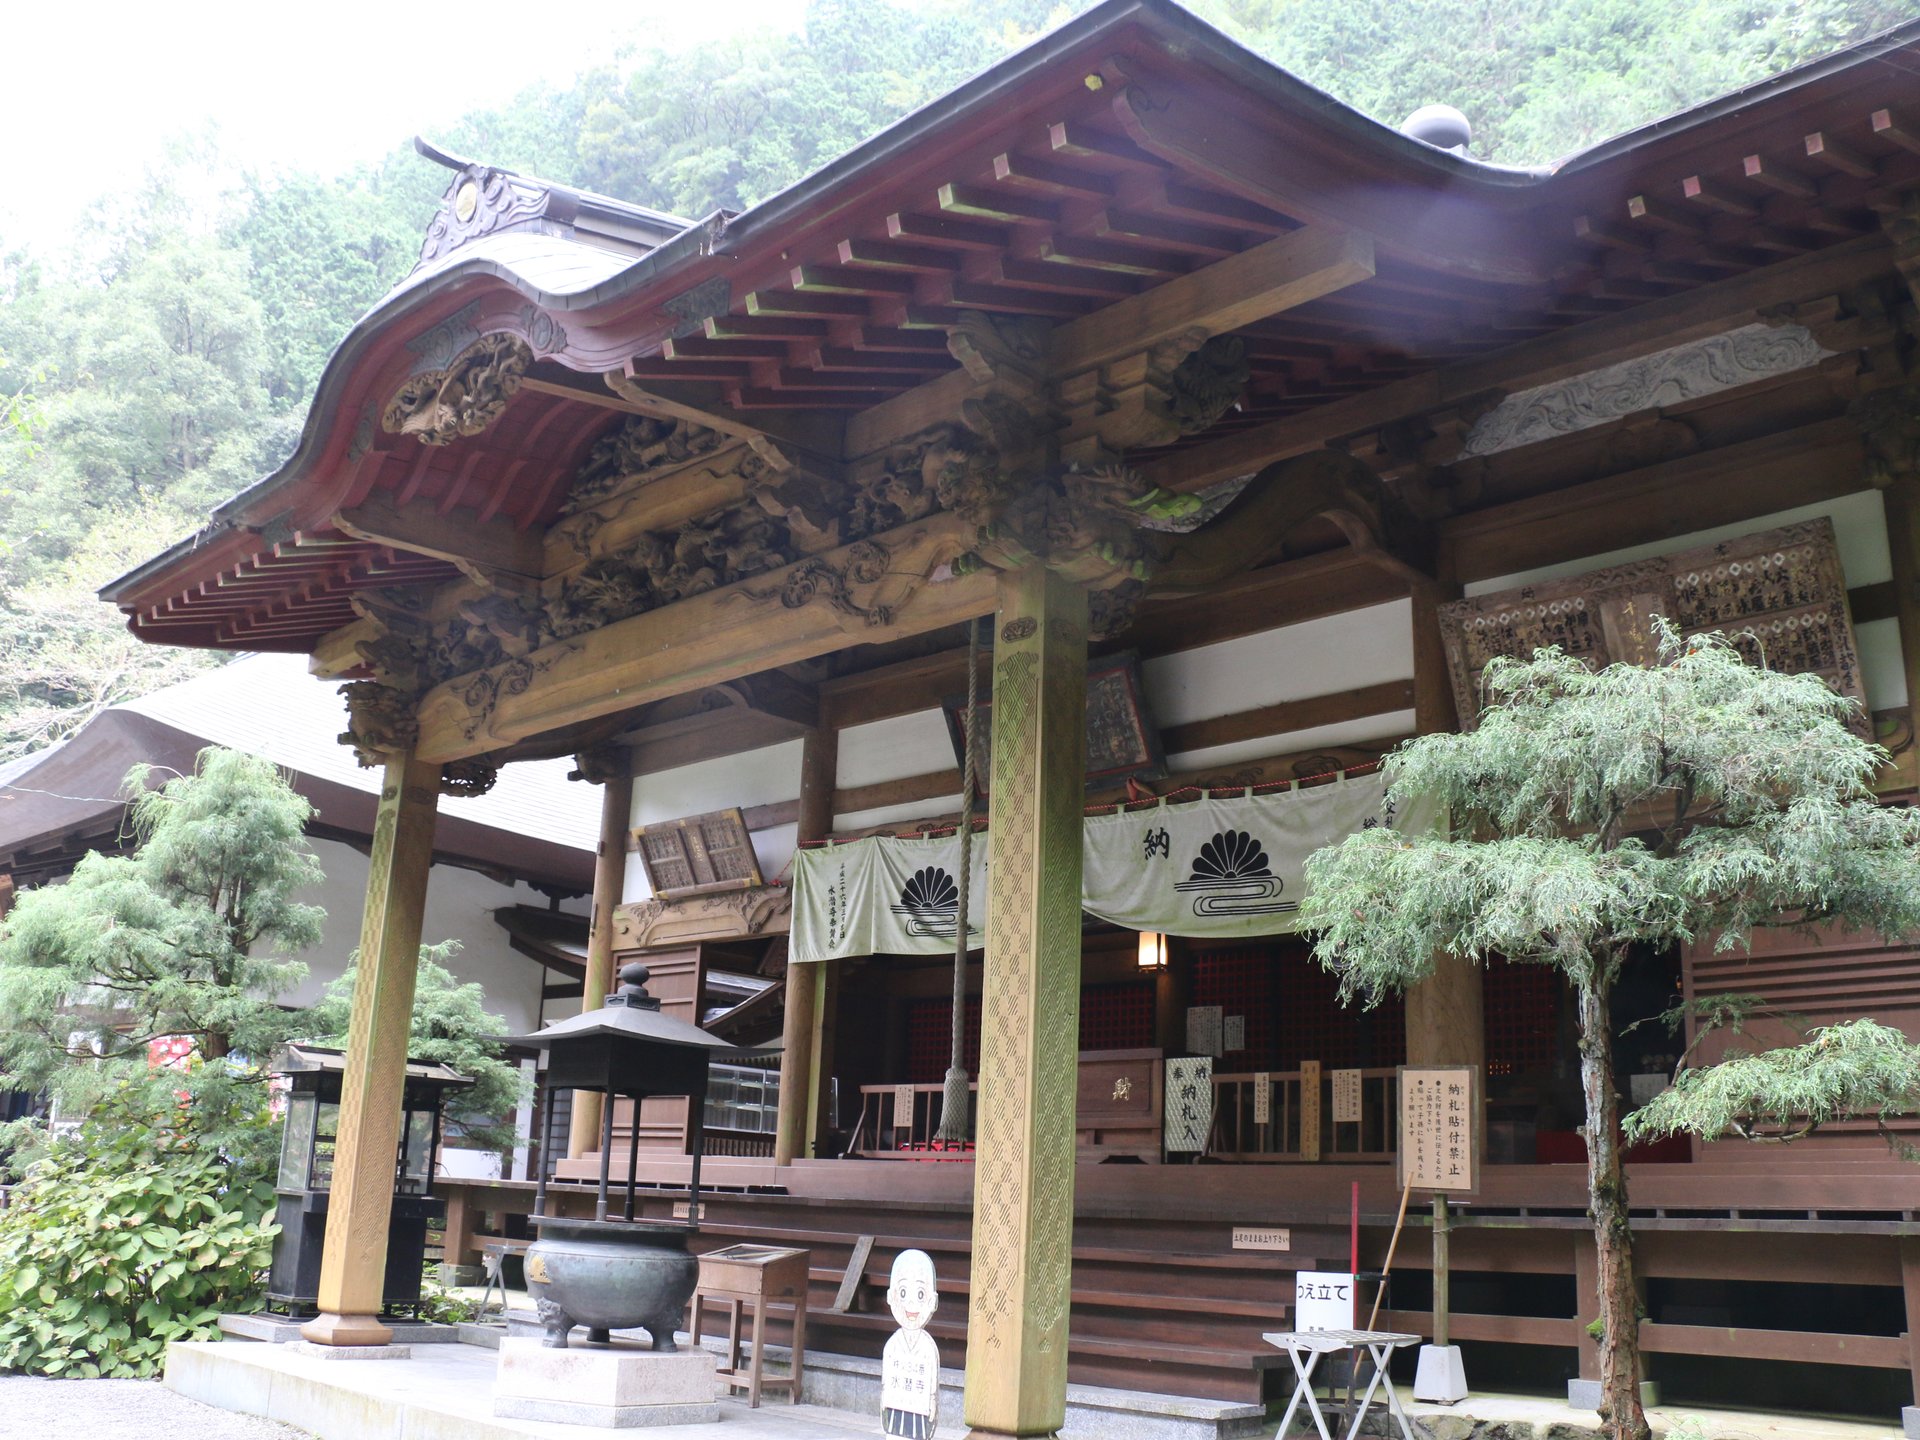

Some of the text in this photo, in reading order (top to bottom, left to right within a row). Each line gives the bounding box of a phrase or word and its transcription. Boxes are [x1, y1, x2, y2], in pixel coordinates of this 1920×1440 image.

[1143, 827, 1170, 860] 納
[1112, 1077, 1132, 1101] 財
[1181, 1084, 1197, 1142] 納札入
[1449, 1084, 1460, 1176] 納札貼付禁止
[1298, 1283, 1349, 1301] つえ立て
